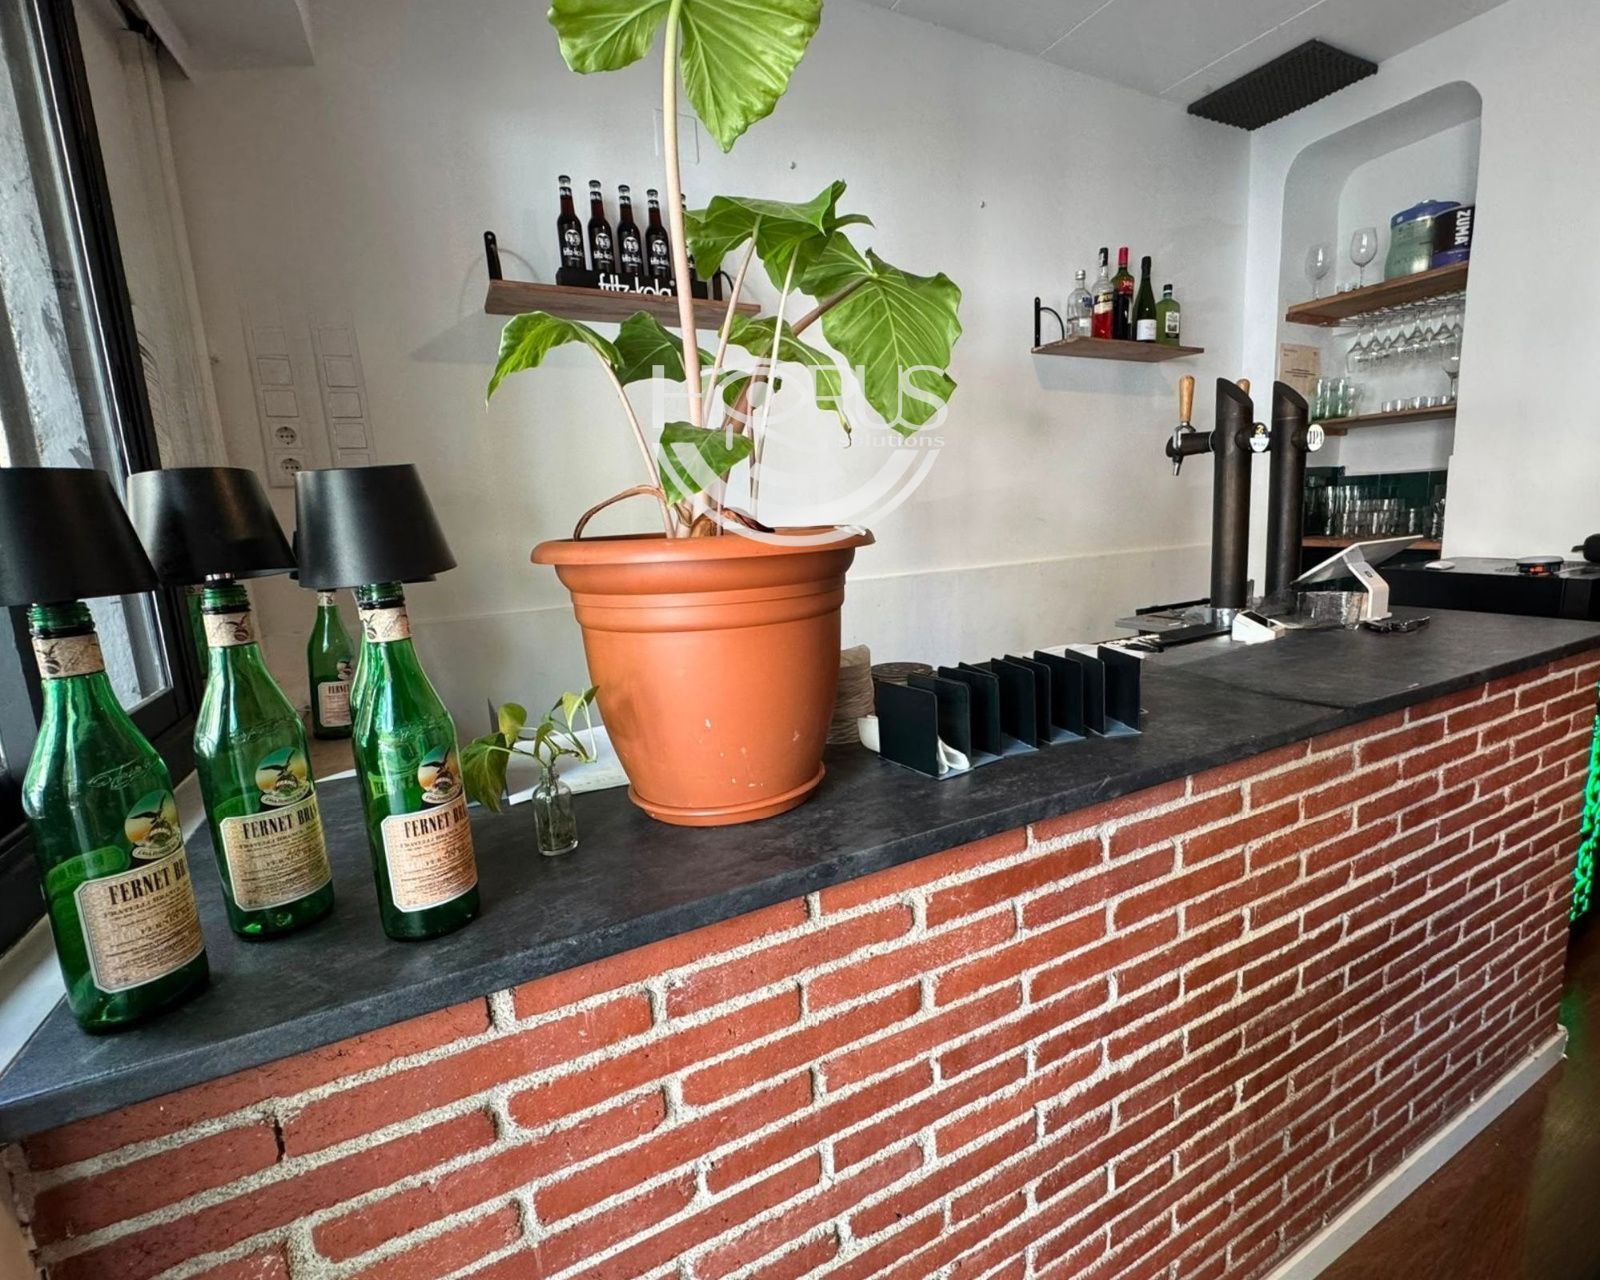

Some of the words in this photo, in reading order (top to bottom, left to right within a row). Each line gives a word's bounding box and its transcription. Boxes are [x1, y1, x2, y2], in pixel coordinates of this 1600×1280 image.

[1454, 209, 1472, 245] ZUMA
[243, 813, 294, 840] FERNET
[404, 811, 451, 838] FERNET
[108, 866, 171, 905] FERNET
